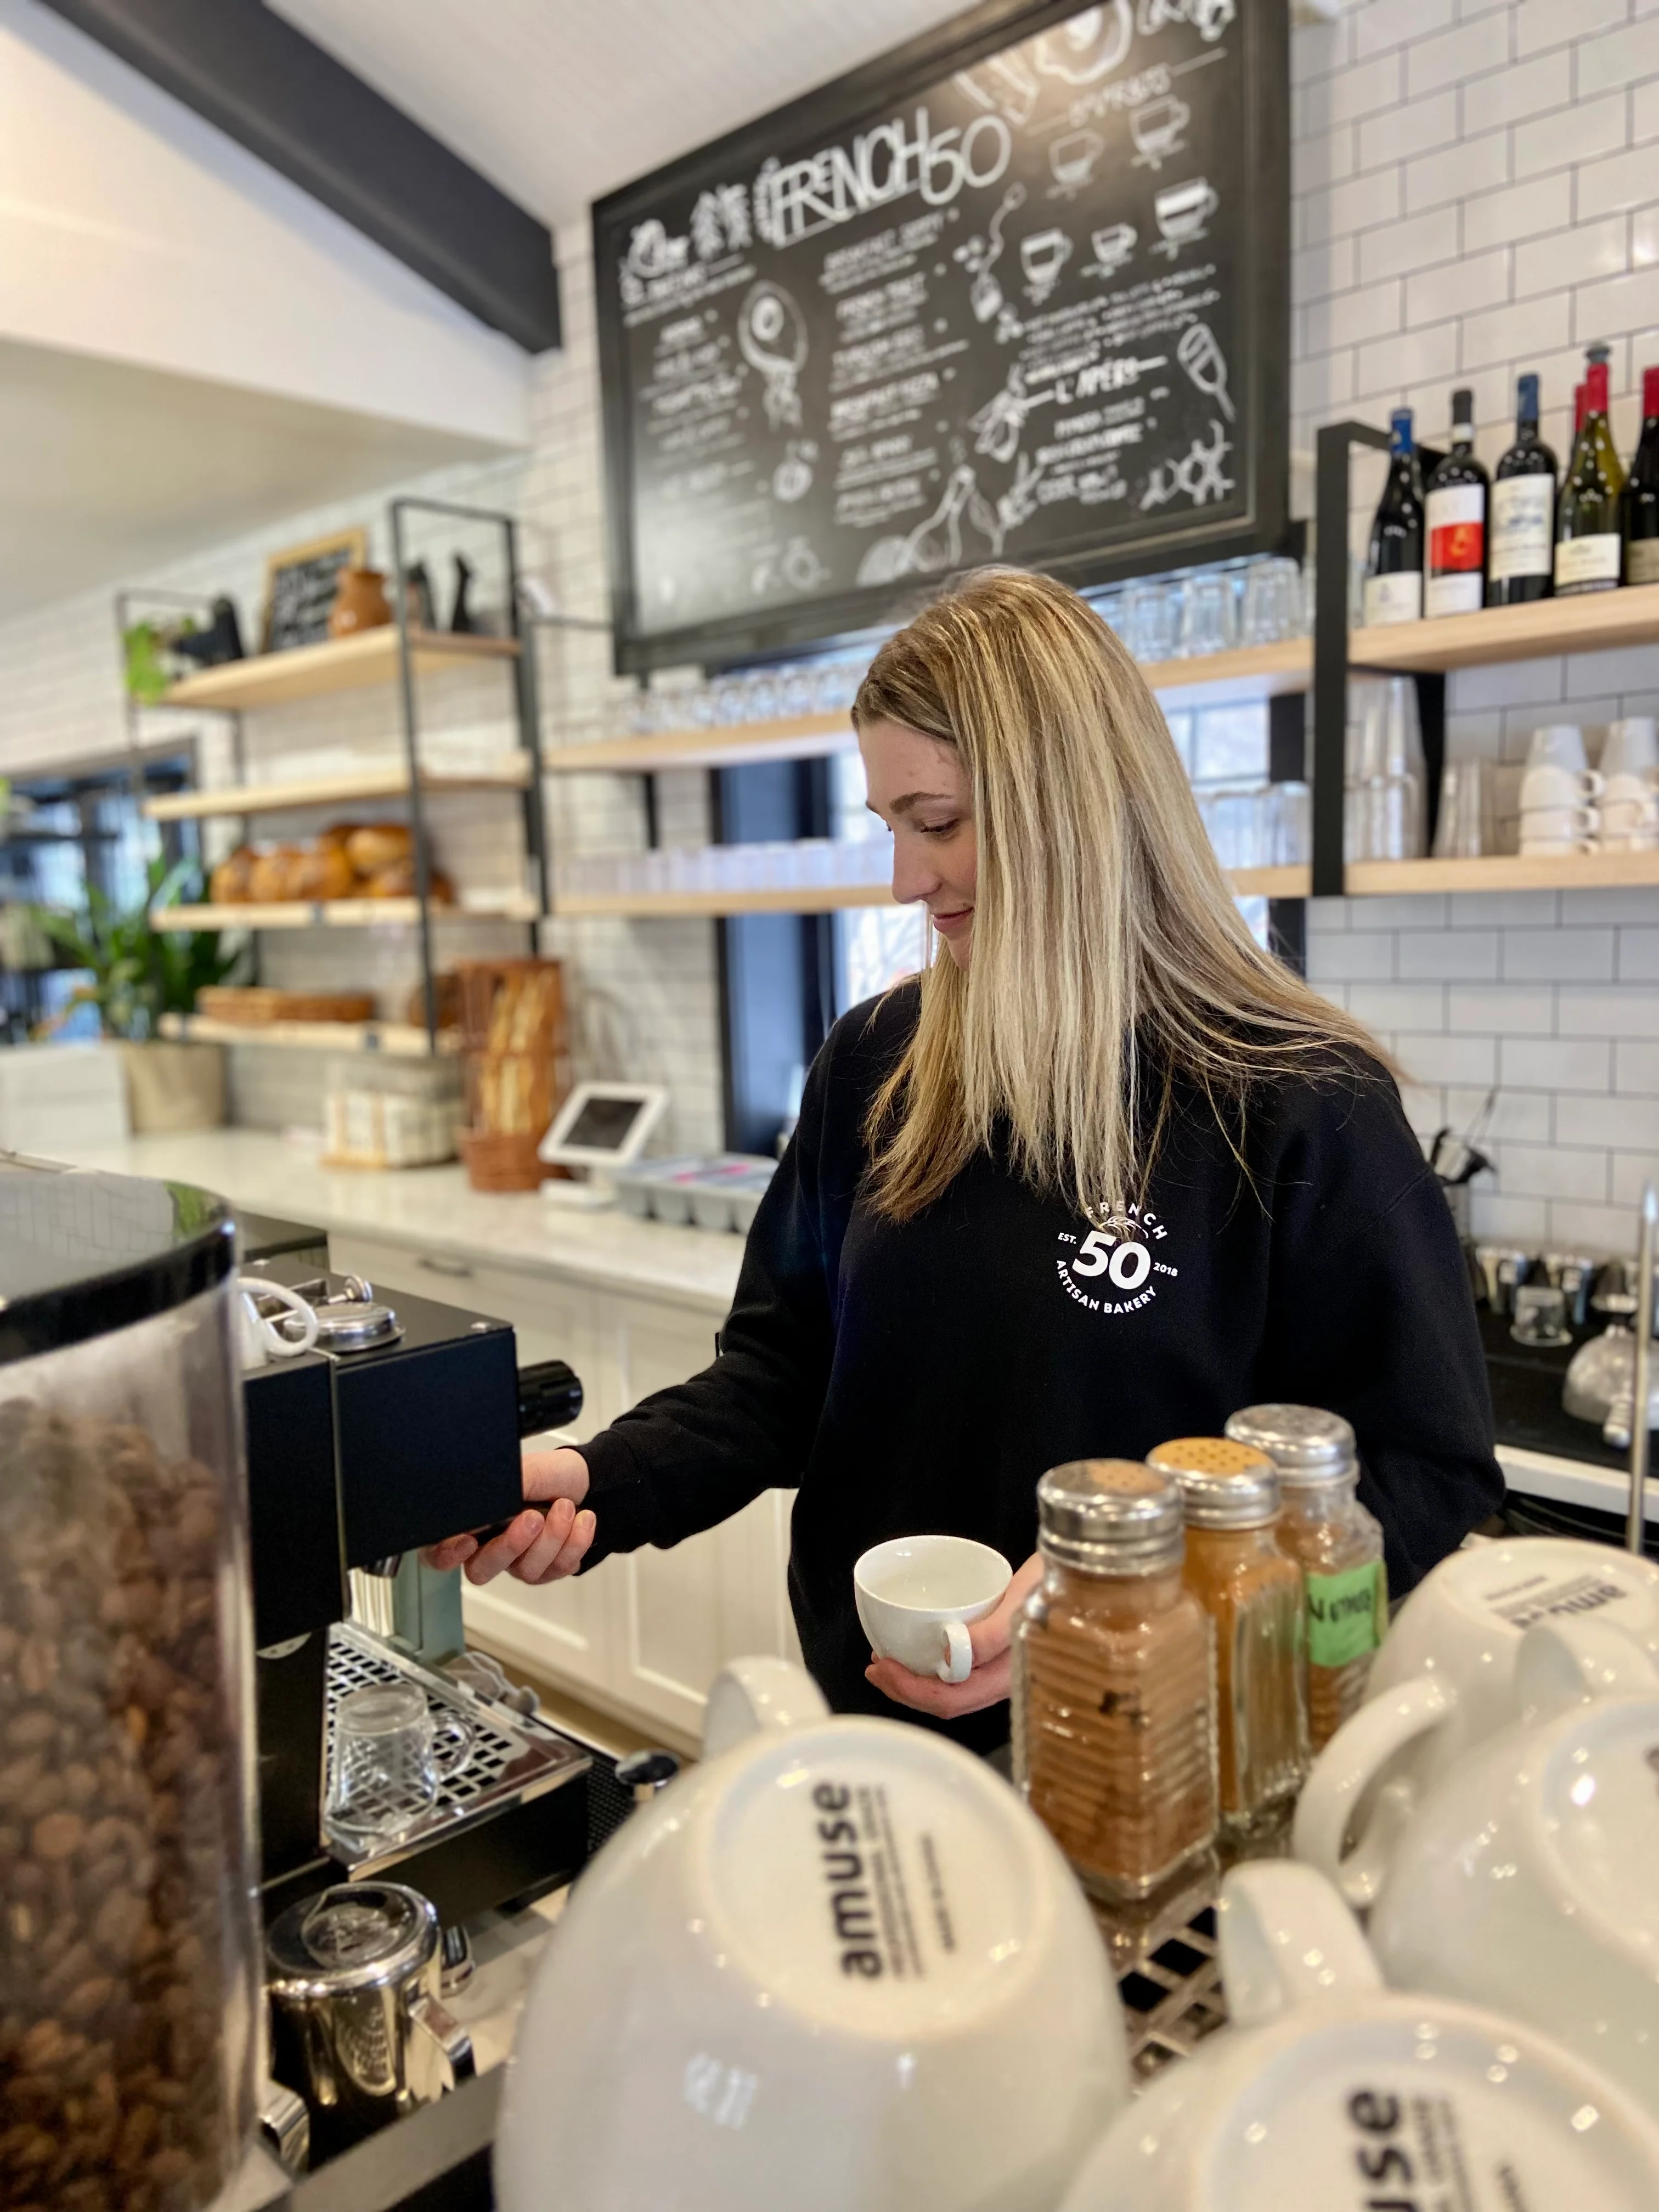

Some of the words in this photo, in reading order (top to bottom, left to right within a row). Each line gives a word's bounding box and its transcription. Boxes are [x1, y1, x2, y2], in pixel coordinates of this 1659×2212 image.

[1057, 1232, 1077, 1245] EST.
[1084, 1200, 1168, 1240] FRENCH
[1072, 1230, 1151, 1290] 50
[1153, 1262, 1178, 1277] 2018
[1057, 1260, 1100, 1311] ARTISAN
[1103, 1285, 1157, 1314] BAKERY
[812, 1782, 884, 1980] amuse
